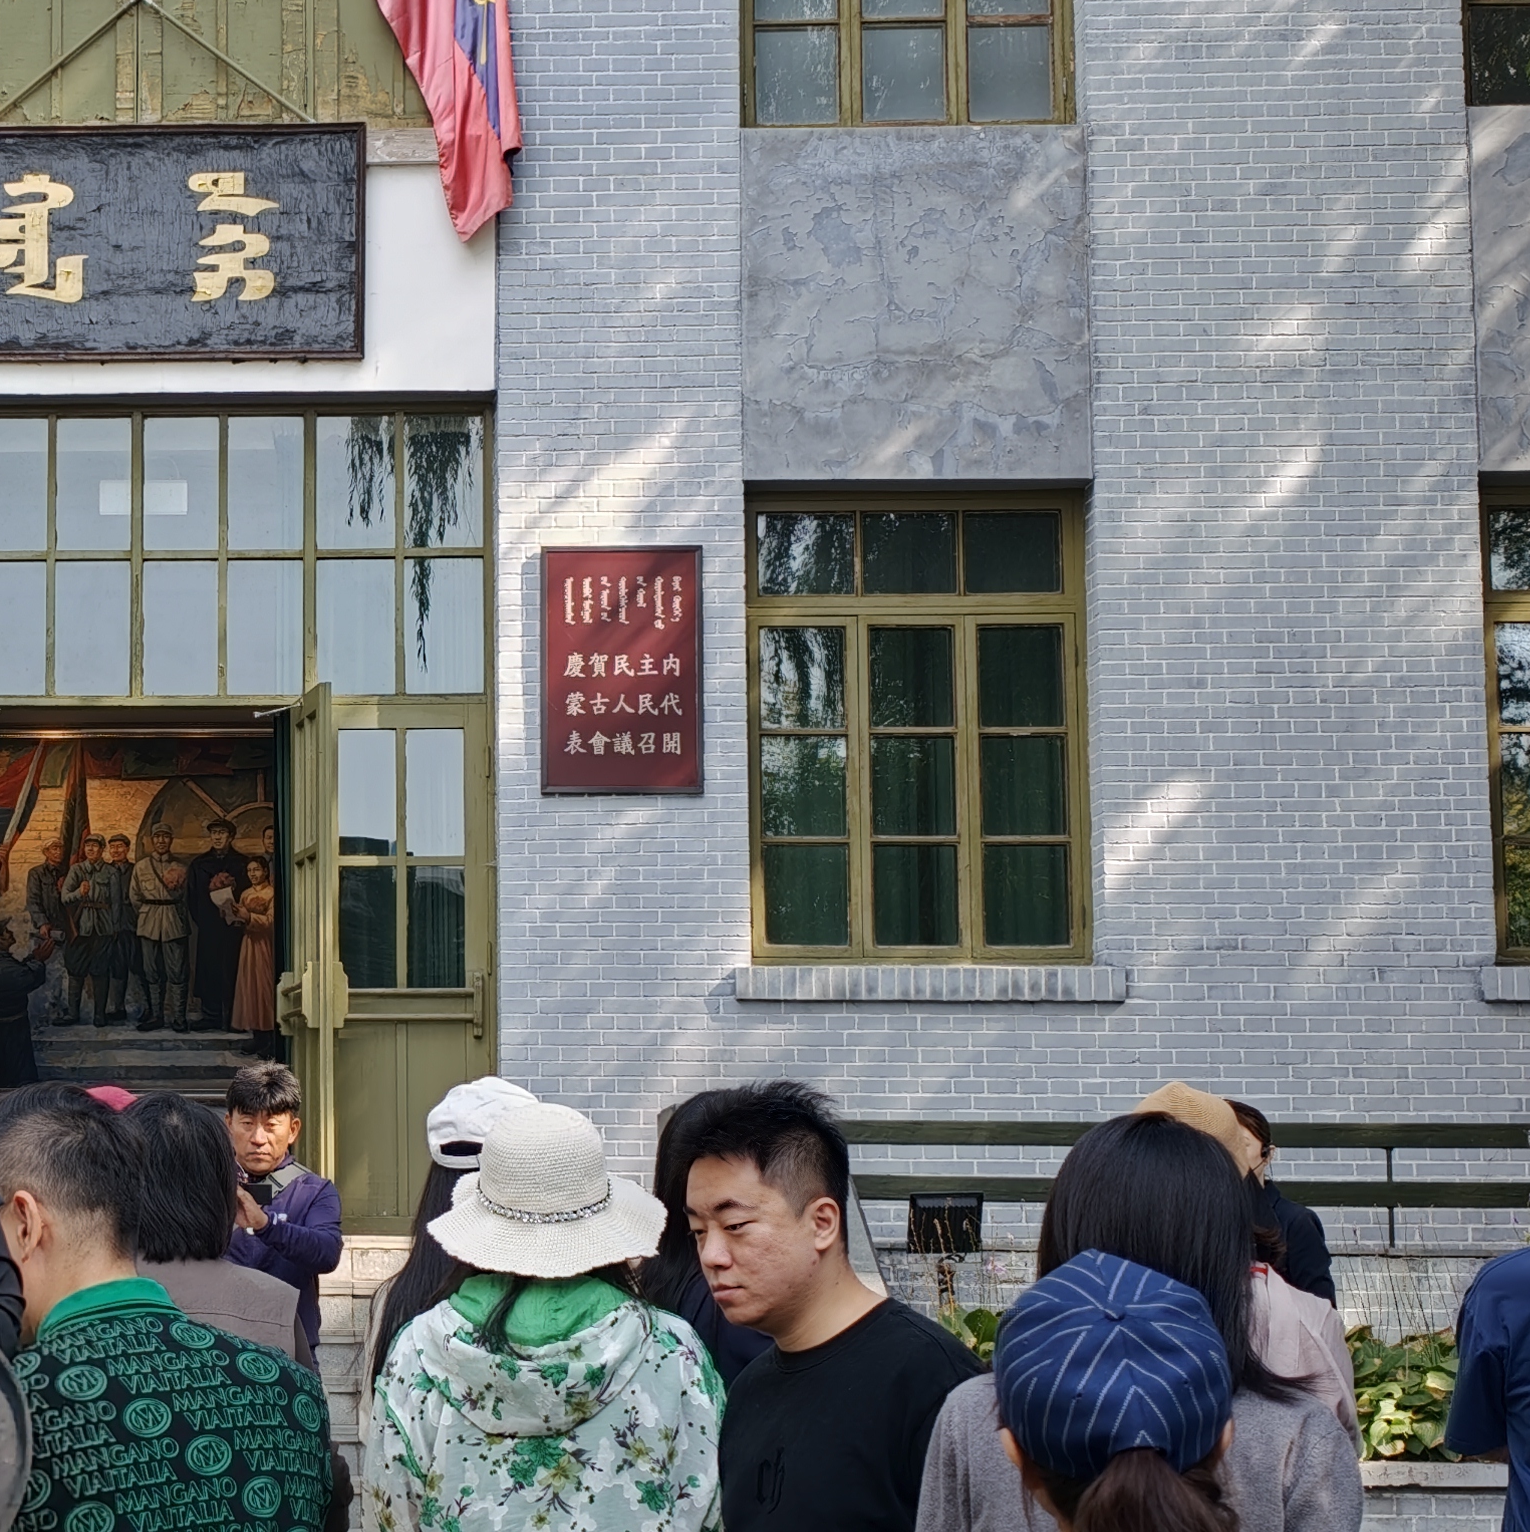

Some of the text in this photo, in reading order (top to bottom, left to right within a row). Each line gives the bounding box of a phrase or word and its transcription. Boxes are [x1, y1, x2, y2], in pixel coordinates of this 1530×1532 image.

[565, 692, 682, 715] 蒙古人民代
[564, 731, 681, 755] 表會議召開
[55, 1335, 166, 1364] VIAITALIA
[106, 1349, 230, 1377] MANGANO
[120, 1367, 232, 1394] VIAITALIA
[171, 1385, 288, 1412] MANGANO
[32, 1400, 116, 1434] GANO
[183, 1406, 288, 1430] VIAITALIA
[52, 1437, 179, 1480] MANGANO
[65, 1461, 178, 1498] VIAITALIA
[115, 1476, 237, 1514] MANGANO
[128, 1500, 234, 1532] VIAITALIA
